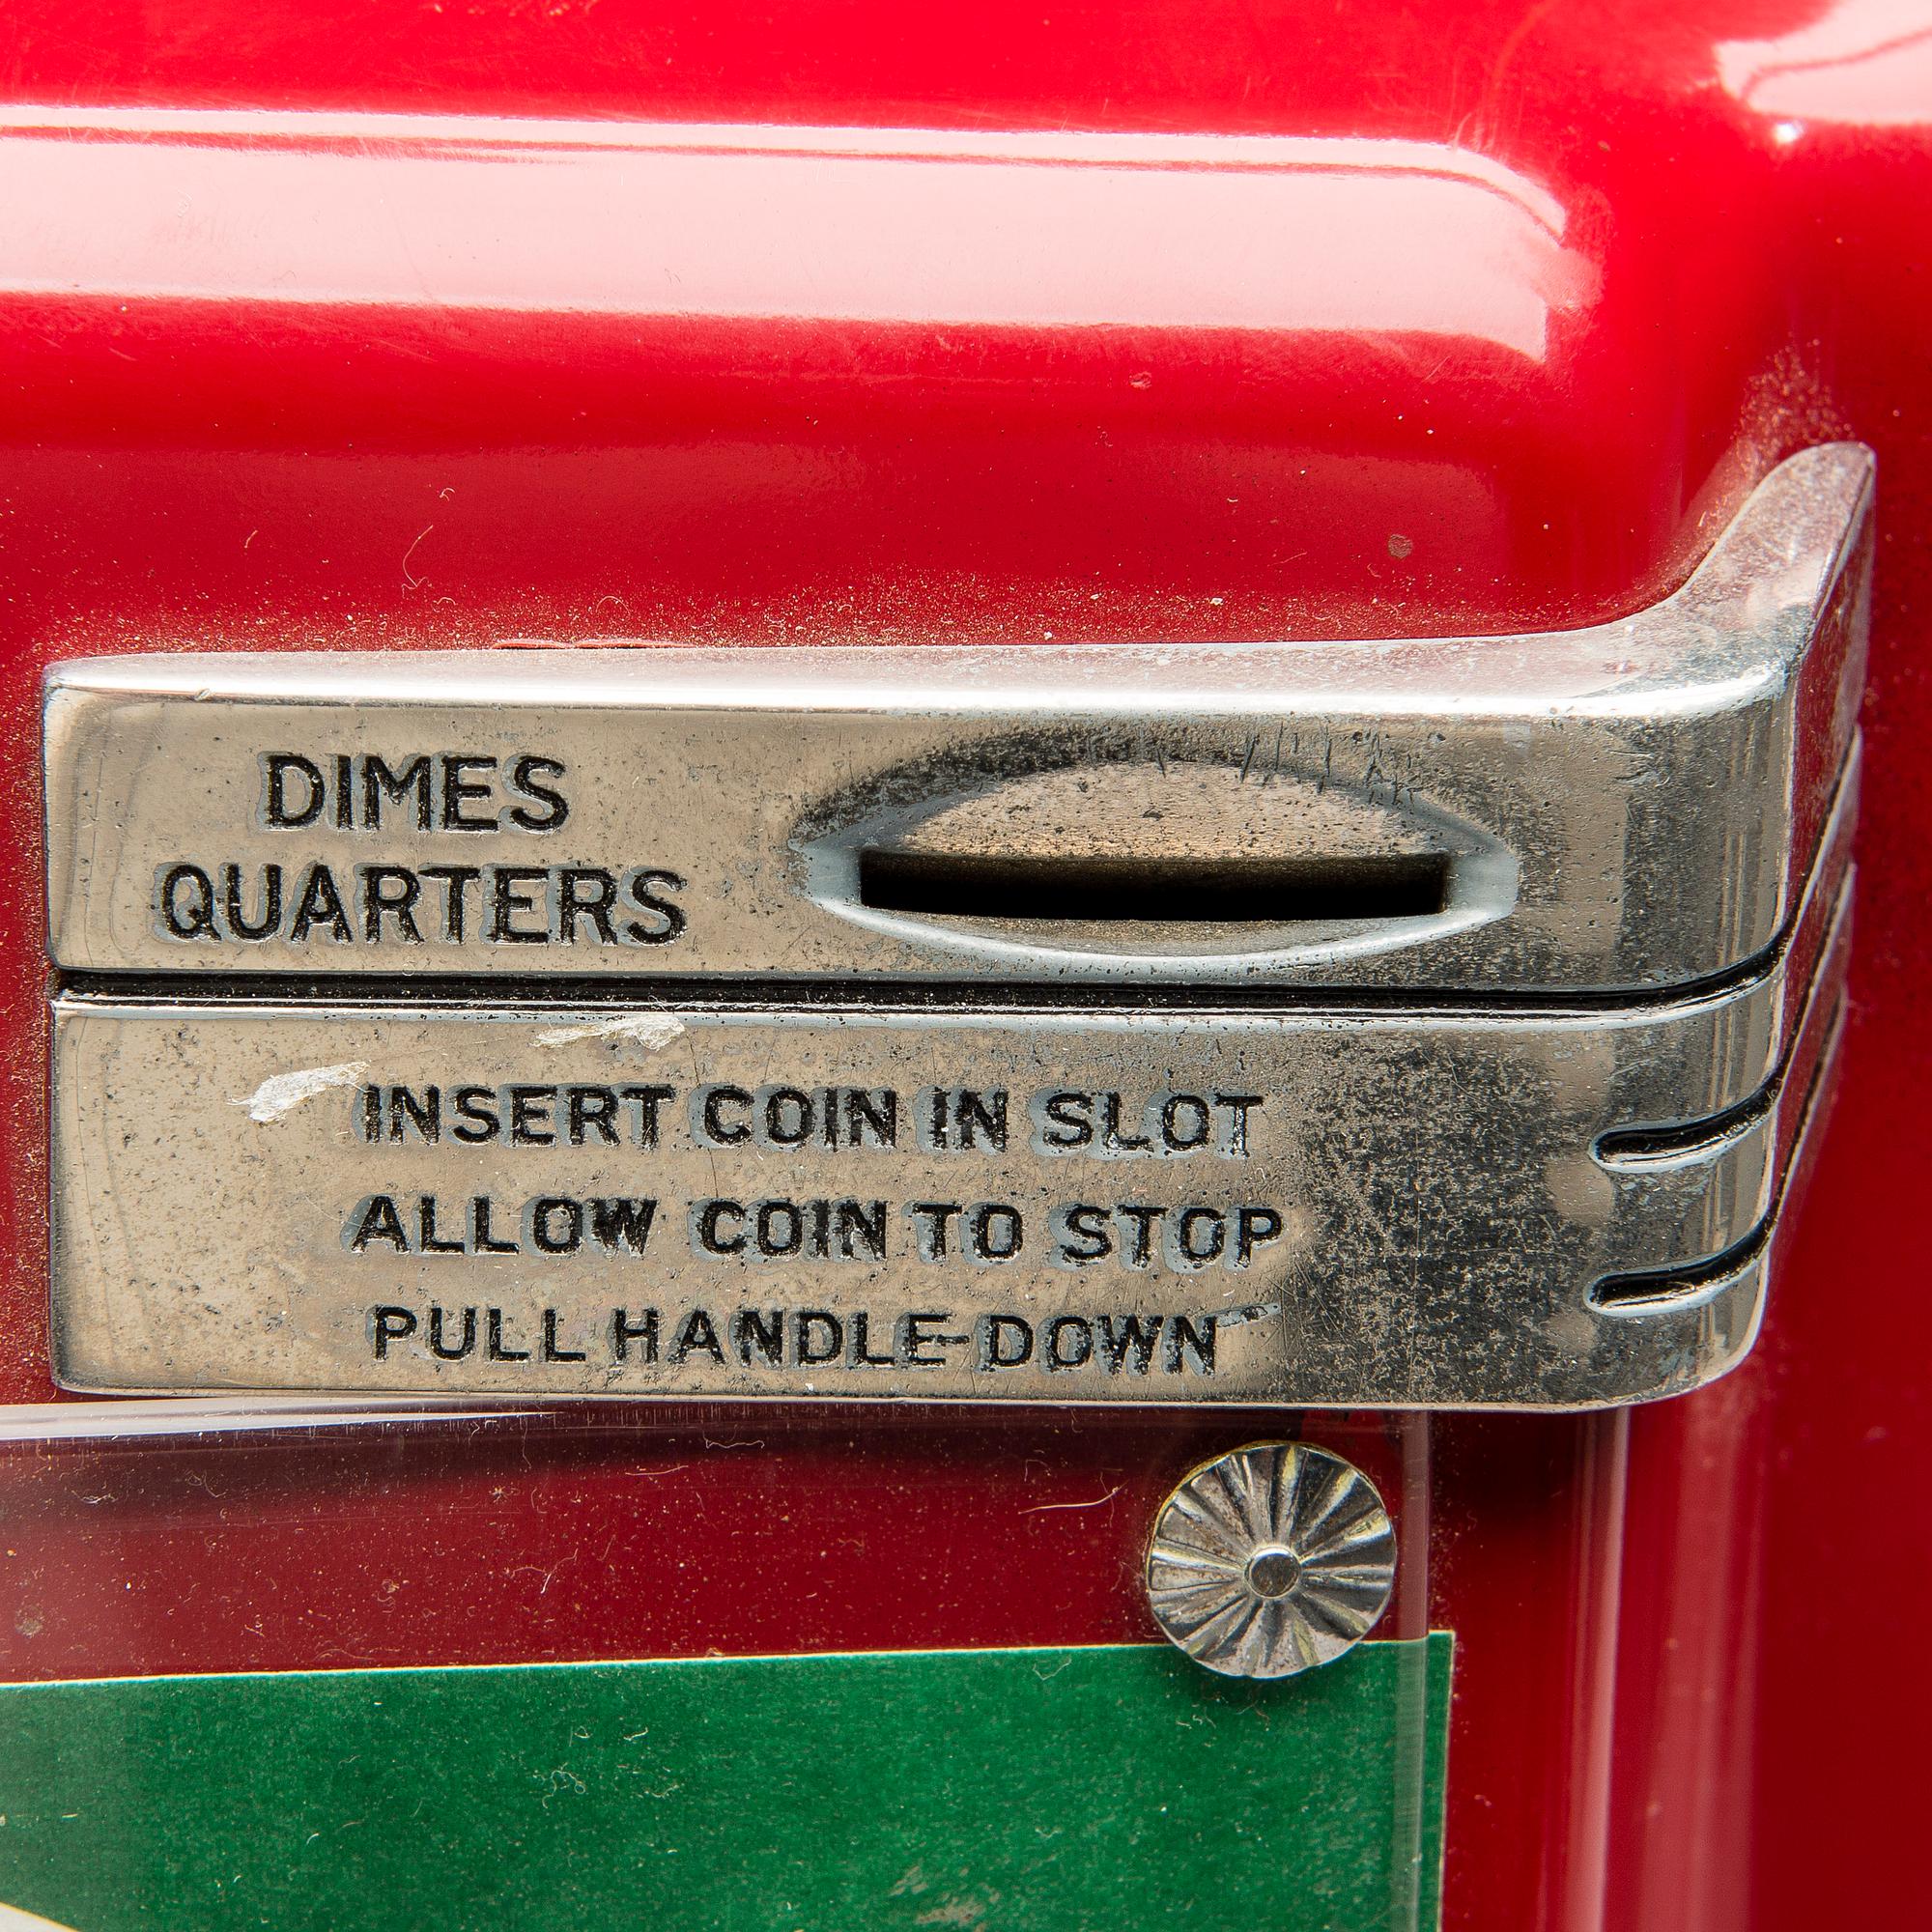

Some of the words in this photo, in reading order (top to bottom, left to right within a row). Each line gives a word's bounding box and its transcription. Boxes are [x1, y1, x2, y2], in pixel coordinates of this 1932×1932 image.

[262, 752, 570, 833] DIMES
[156, 863, 688, 945] QUARTERS
[357, 1083, 676, 1147] INSERT
[697, 1084, 897, 1151] COIN
[919, 1087, 1009, 1153] IN
[1034, 1090, 1264, 1159] SLOT
[346, 1195, 657, 1256] ALLOW
[693, 1199, 888, 1262] COIN
[908, 1201, 1025, 1266] TO
[1053, 1203, 1284, 1272] STOP
[368, 1305, 587, 1363] PULL
